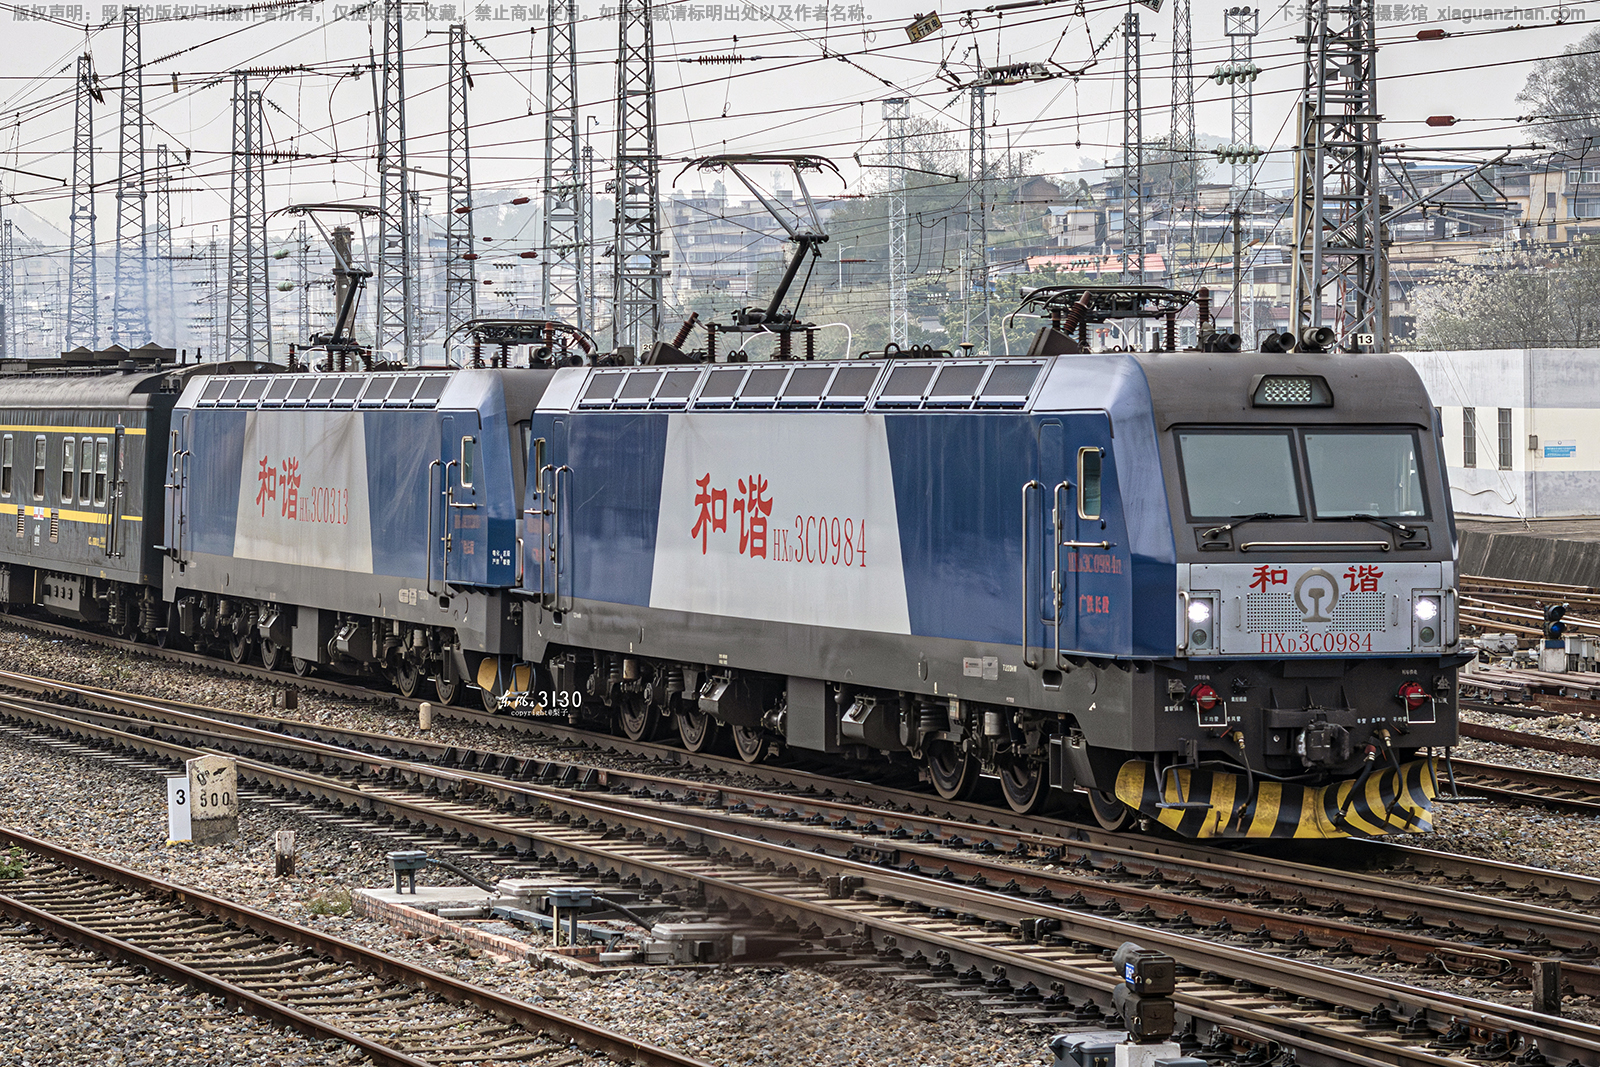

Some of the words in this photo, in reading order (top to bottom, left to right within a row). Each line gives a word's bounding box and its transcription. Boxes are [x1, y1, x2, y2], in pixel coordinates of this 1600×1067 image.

[255, 455, 301, 521] 和谐
[691, 472, 774, 560] 和谐
[773, 515, 867, 567] HXD3C0984
[1249, 564, 1288, 593] 和
[1343, 564, 1384, 593] 谐
[1260, 632, 1373, 653] HXD3C0984
[176, 789, 186, 805] 3
[200, 789, 230, 807] 500
